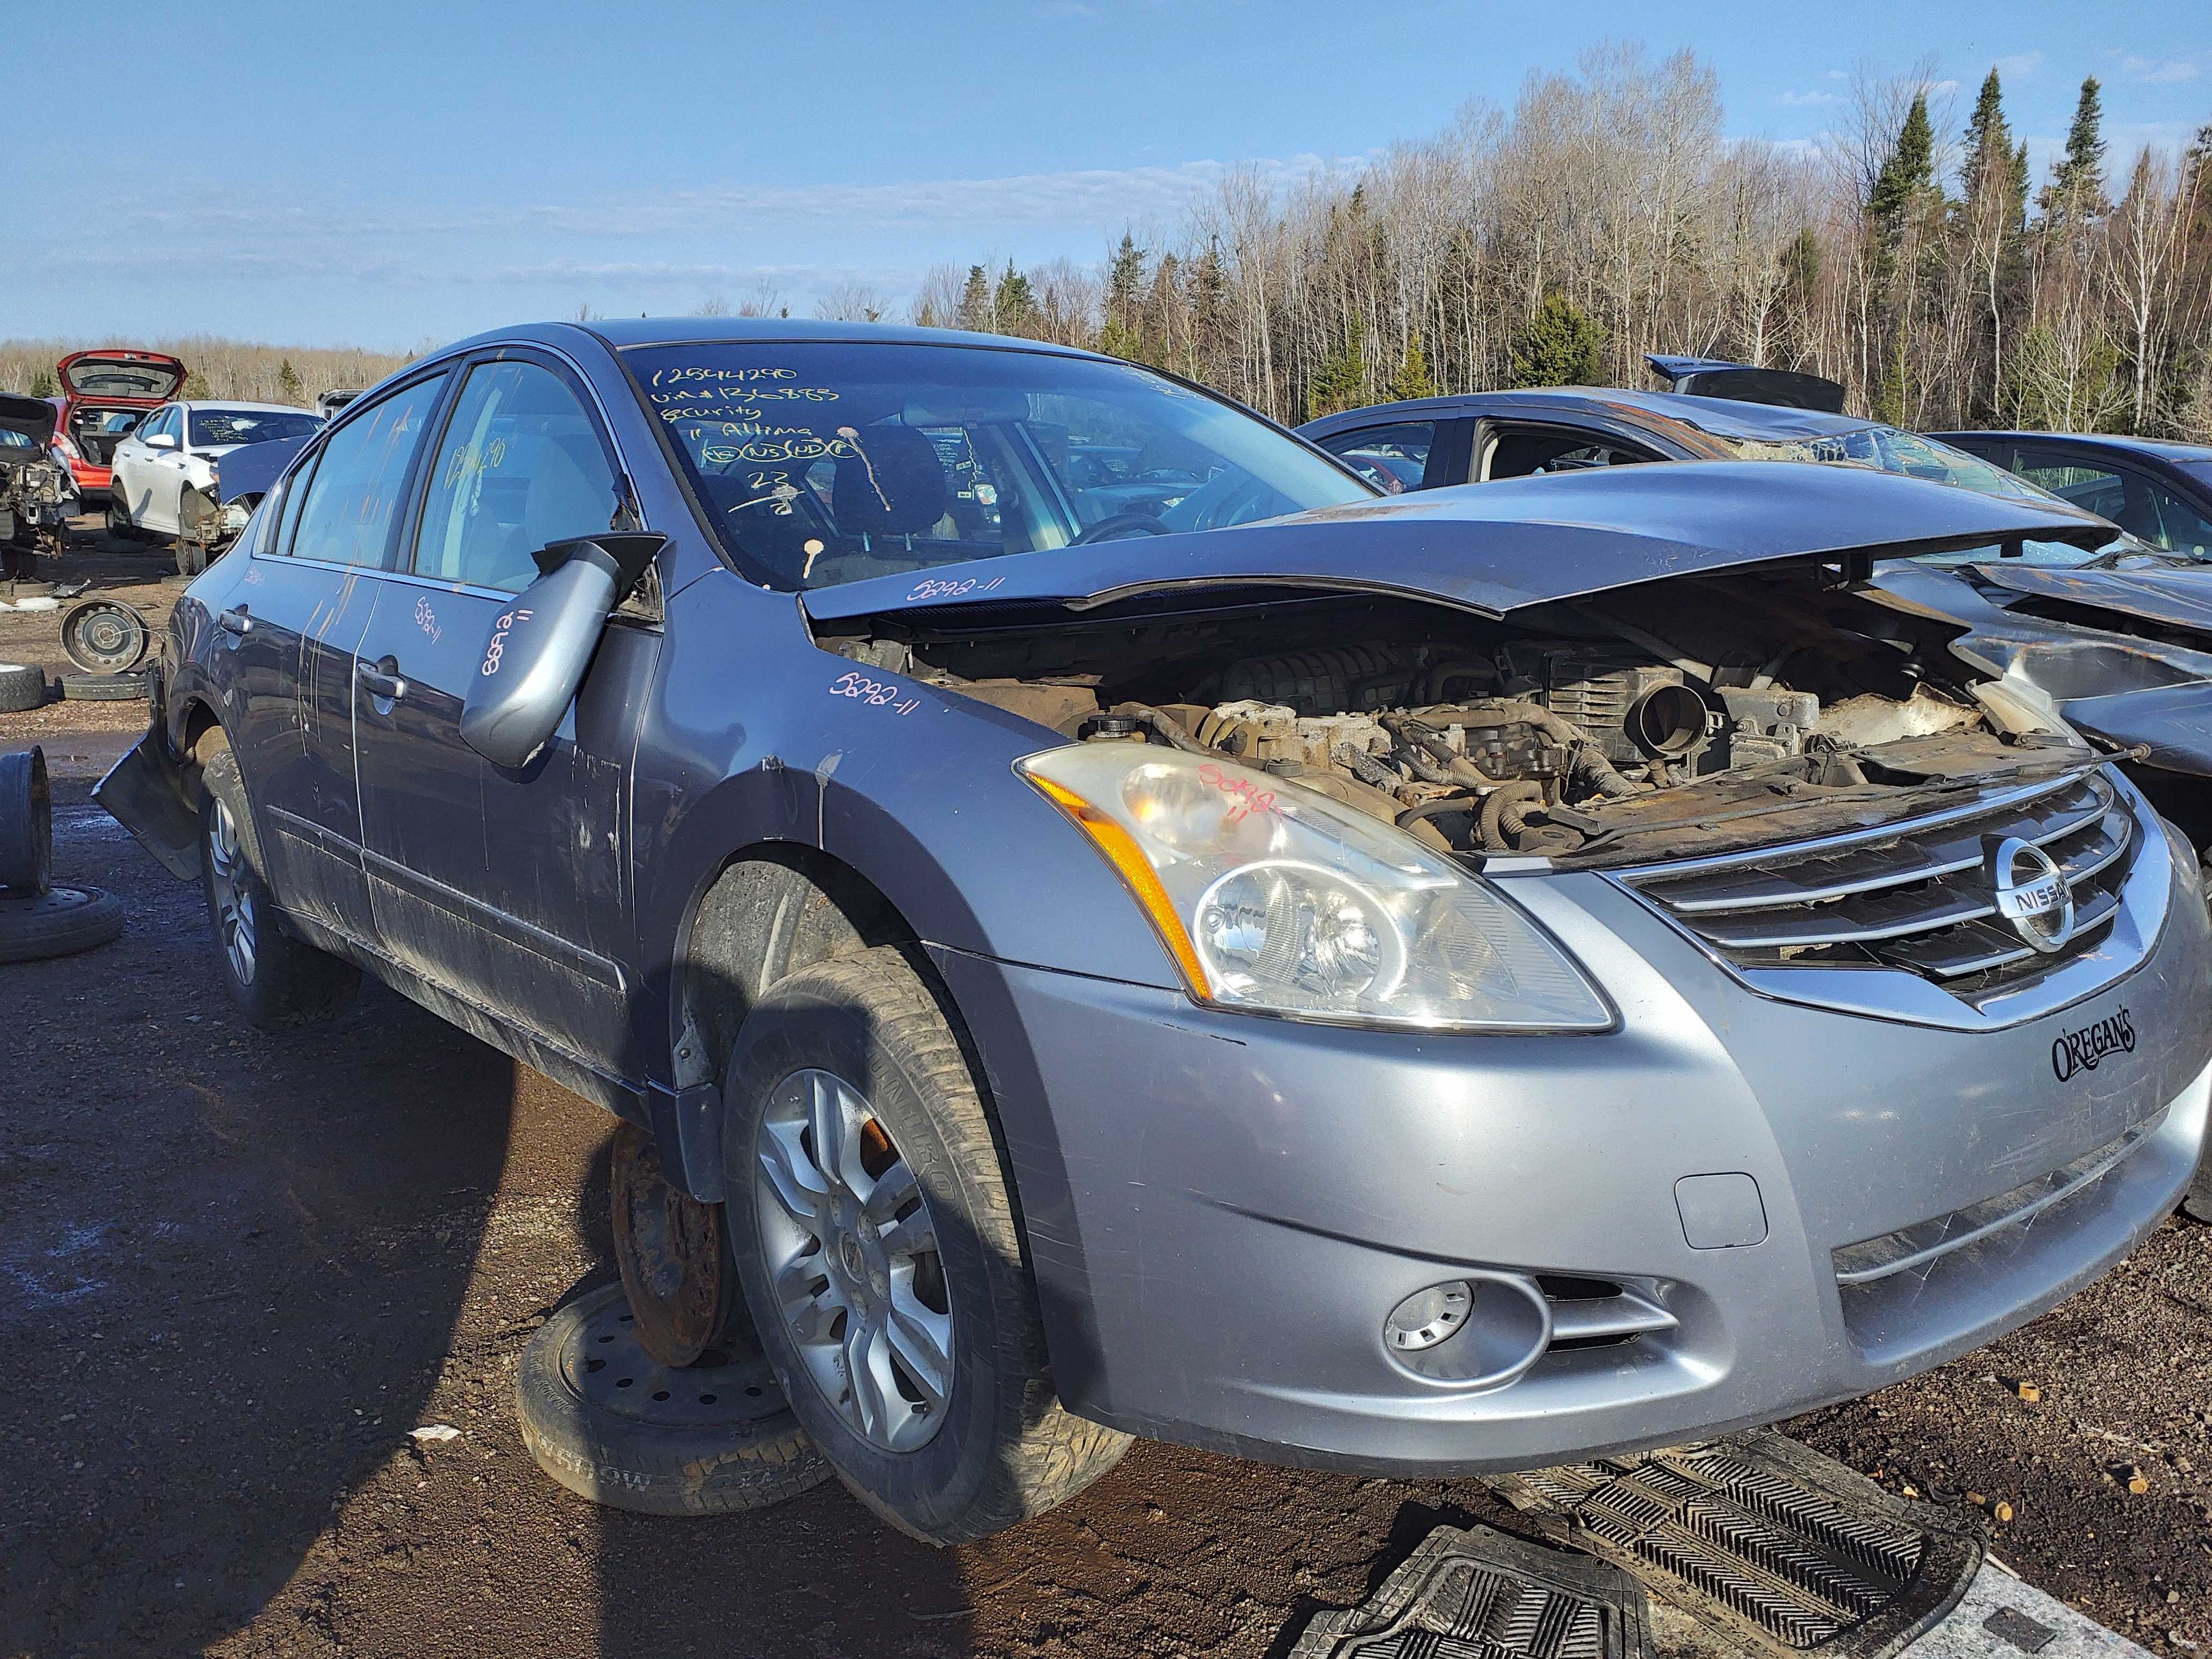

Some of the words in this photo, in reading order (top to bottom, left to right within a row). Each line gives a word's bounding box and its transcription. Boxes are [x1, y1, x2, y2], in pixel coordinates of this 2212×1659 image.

[906, 577, 1006, 601] 5292-11
[829, 672, 921, 716] 5292-11
[2052, 1004, 2135, 1082] O'REGAN'S
